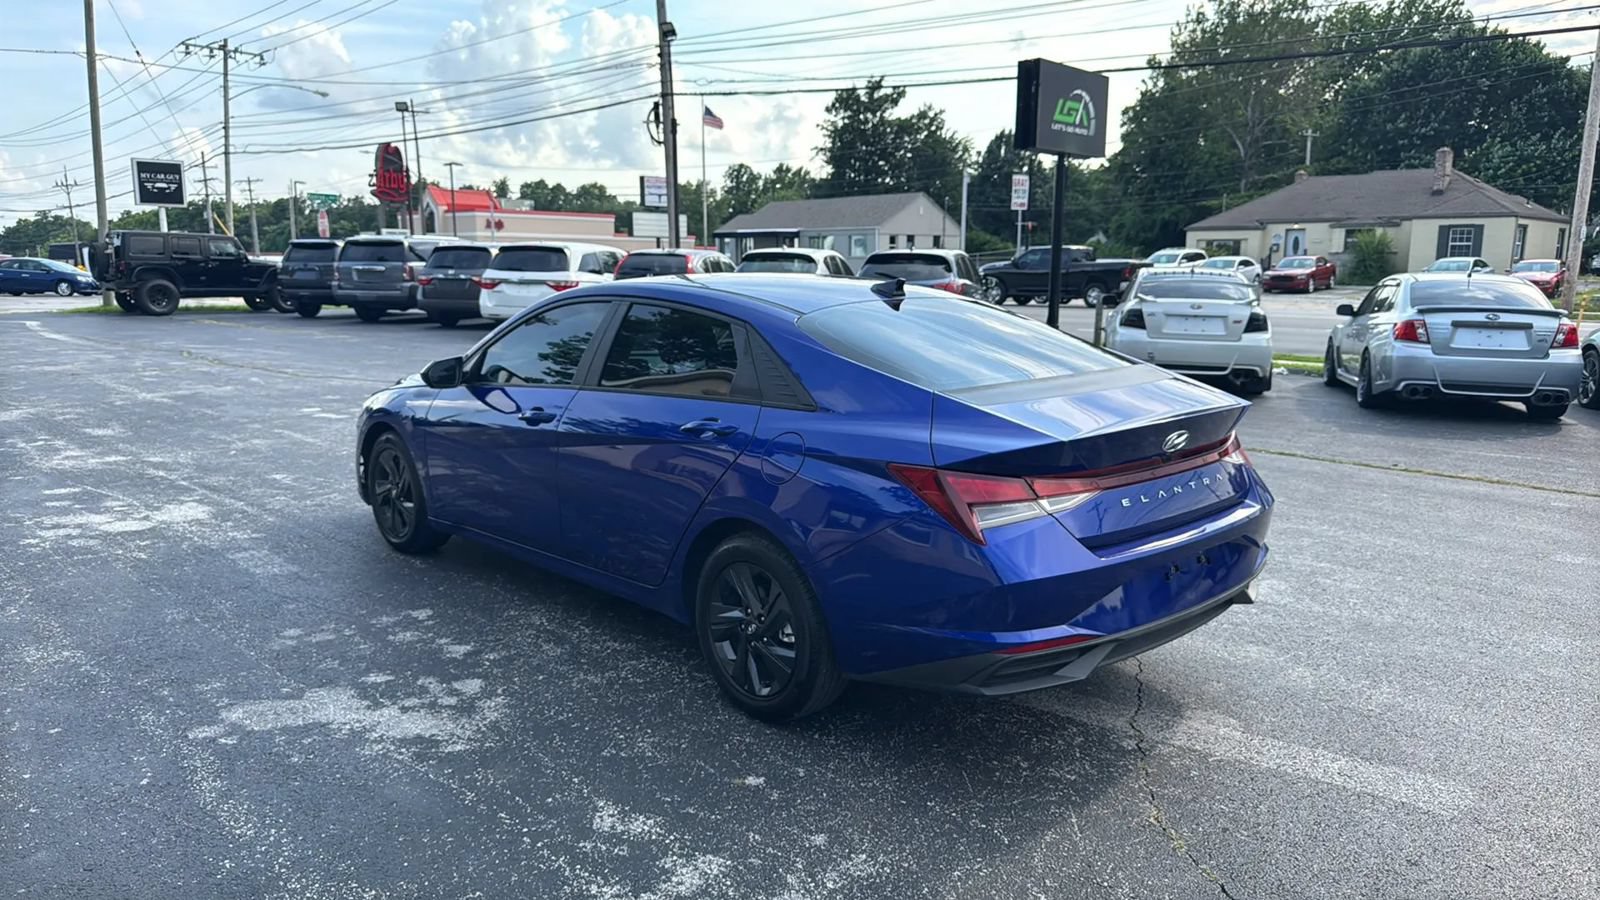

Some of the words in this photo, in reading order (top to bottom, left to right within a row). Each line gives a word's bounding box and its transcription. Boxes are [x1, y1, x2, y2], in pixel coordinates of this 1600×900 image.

[1051, 123, 1066, 131] LET'S
[1075, 127, 1089, 136] AUTO
[1121, 474, 1223, 507] ELANTRA
